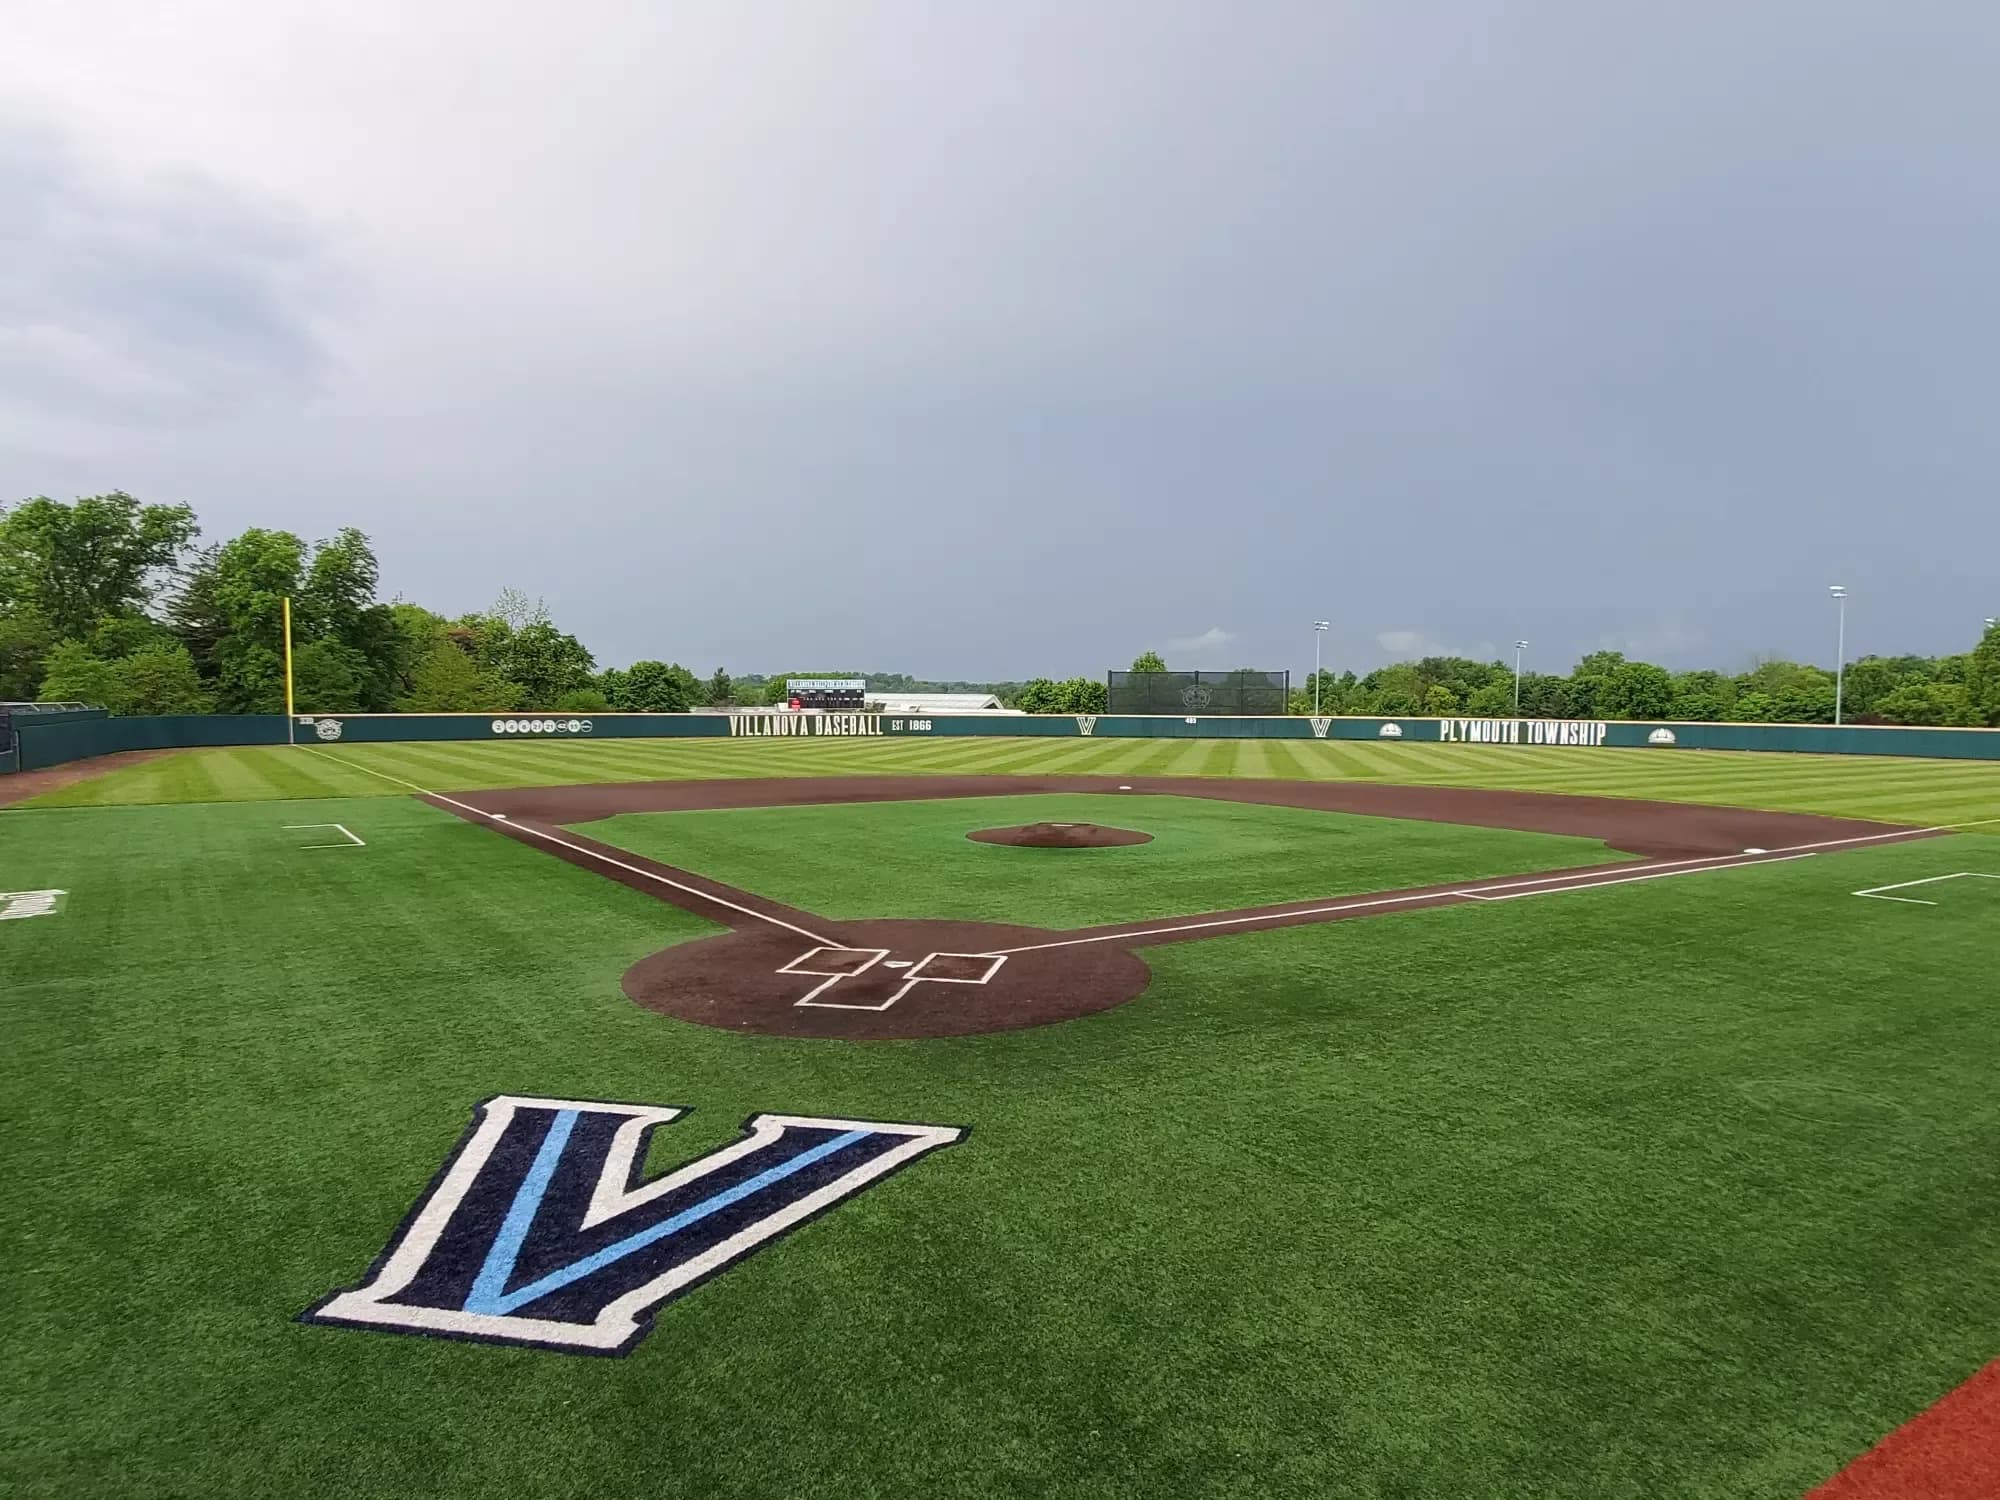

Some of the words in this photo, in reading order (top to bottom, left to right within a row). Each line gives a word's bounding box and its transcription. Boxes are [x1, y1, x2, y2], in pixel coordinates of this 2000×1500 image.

[729, 715, 809, 736] VILLANOVA
[815, 715, 883, 736] BASEBALL
[892, 720, 903, 731] EST
[909, 719, 932, 731] 1866
[1440, 720, 1519, 743] PLYMOUTH
[1527, 722, 1606, 746] TOWNSHIP
[299, 1095, 970, 1356] V
